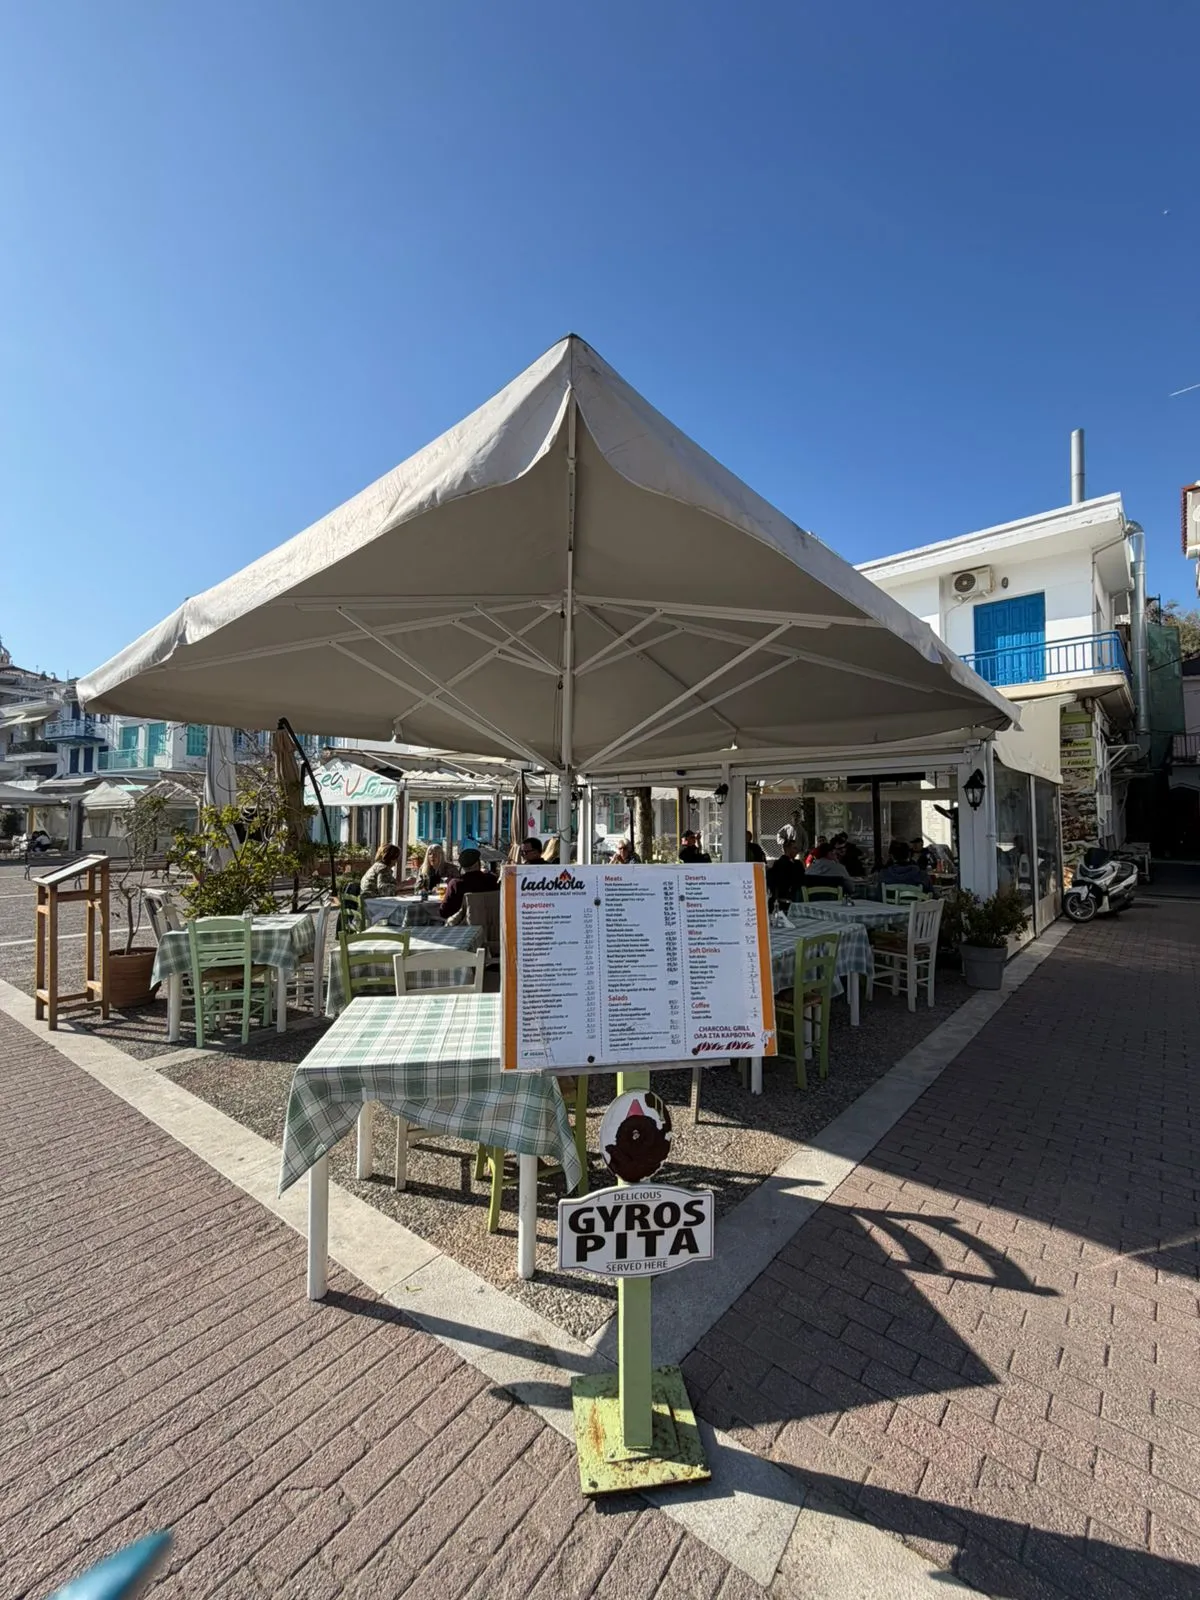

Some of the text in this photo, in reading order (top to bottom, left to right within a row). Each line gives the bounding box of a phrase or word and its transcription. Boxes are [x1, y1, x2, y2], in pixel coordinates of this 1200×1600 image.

[521, 876, 586, 891] ladokola
[614, 1191, 662, 1201] DELICIOUS
[568, 1199, 706, 1235] GYROS
[576, 1227, 700, 1262] PITA
[606, 1260, 668, 1272] SERVED HERE
